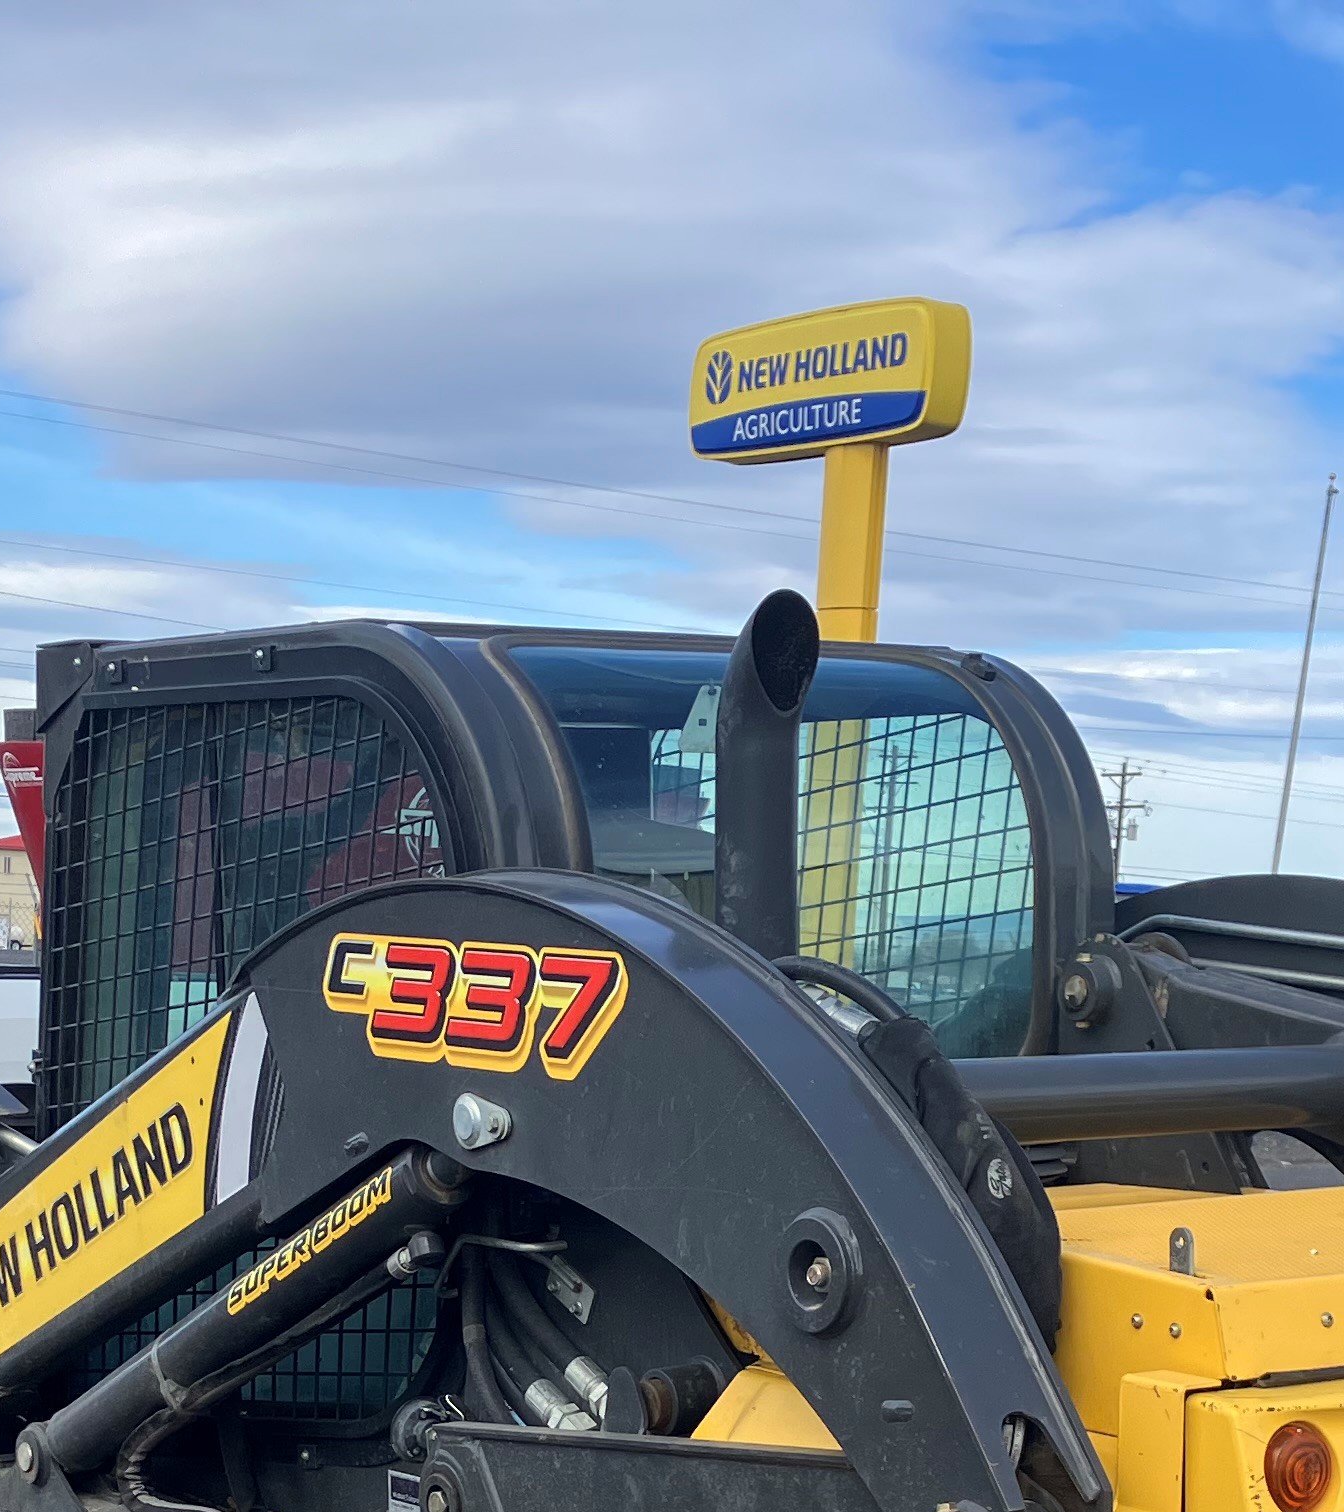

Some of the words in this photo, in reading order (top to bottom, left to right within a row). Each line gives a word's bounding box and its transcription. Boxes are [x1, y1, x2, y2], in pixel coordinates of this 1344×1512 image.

[732, 398, 862, 442] AGRICULTURE
[738, 352, 790, 392] NEW
[794, 332, 908, 382] HOLLAND
[324, 934, 627, 1076] C337
[24, 1102, 194, 1282] HOLLAND
[227, 1229, 312, 1315] SUPER
[312, 1166, 393, 1254] BOOM
